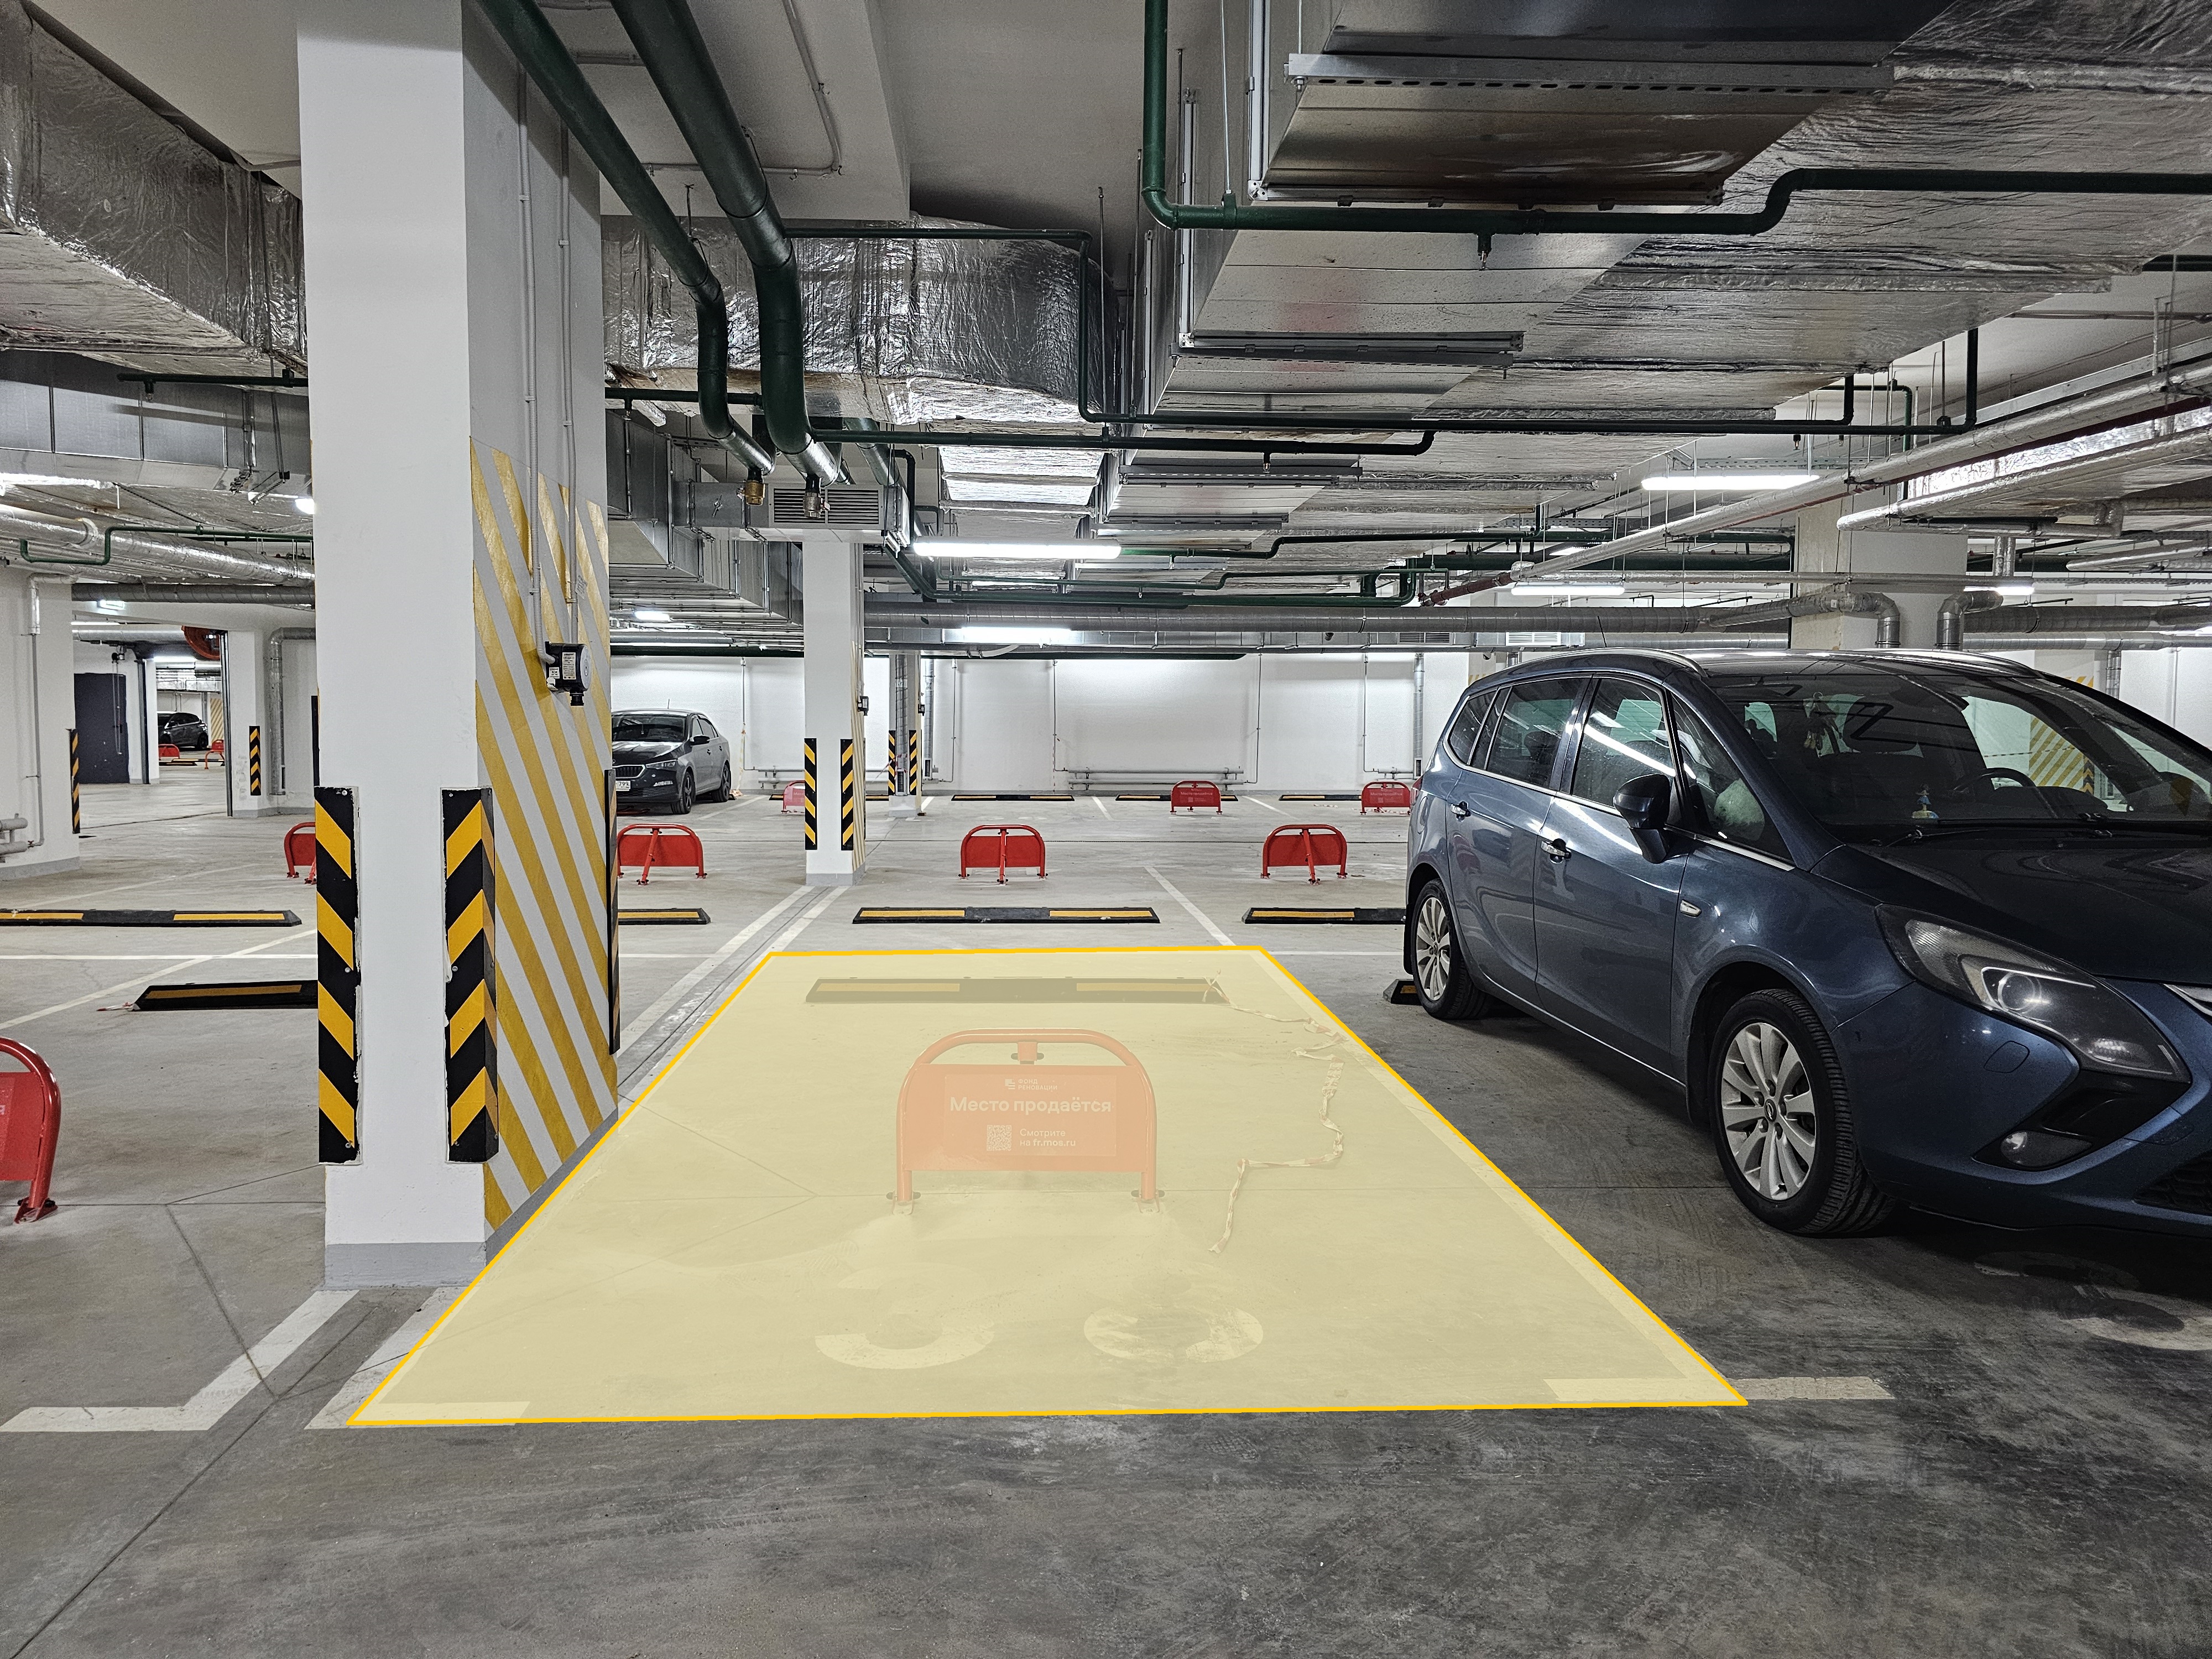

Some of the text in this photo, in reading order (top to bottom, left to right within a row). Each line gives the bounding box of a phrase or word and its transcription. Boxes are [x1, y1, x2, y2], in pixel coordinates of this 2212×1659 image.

[950, 1097, 1111, 1115] Место продаётся
[1020, 1128, 1066, 1138] Смотрите
[1032, 1138, 1076, 1146] fr.mos.ru
